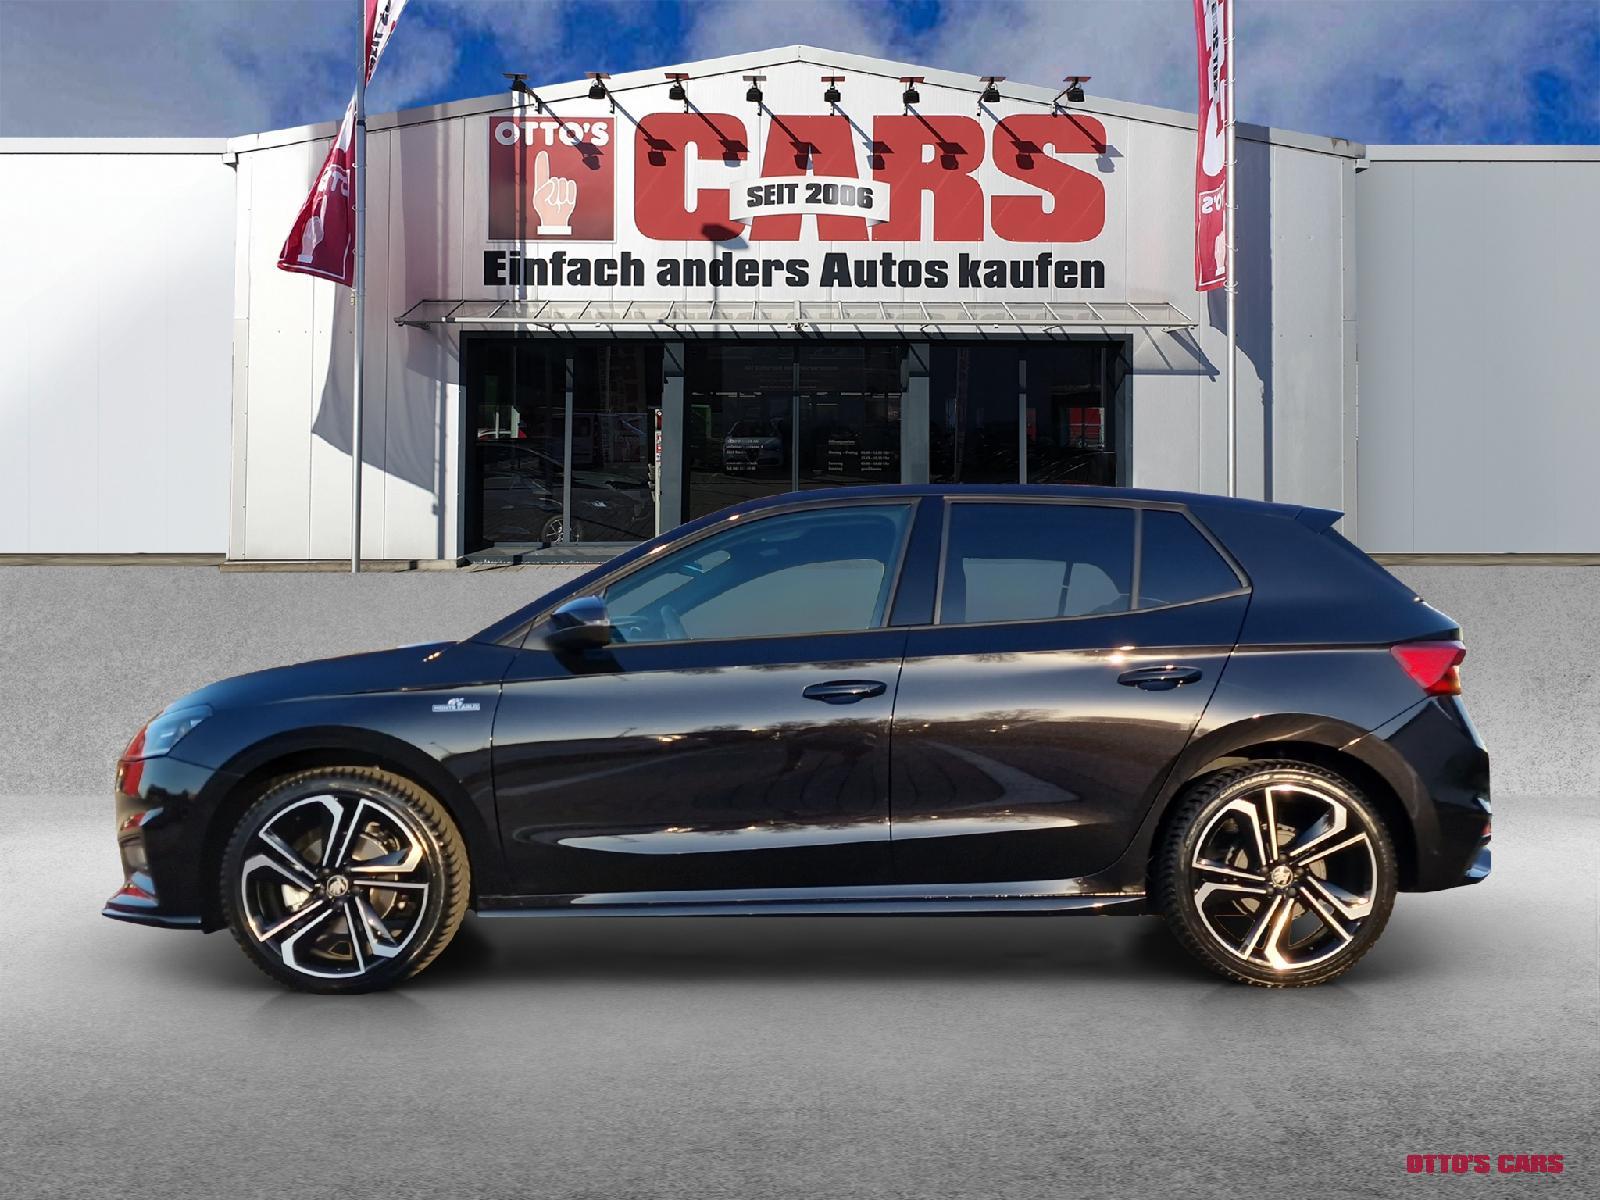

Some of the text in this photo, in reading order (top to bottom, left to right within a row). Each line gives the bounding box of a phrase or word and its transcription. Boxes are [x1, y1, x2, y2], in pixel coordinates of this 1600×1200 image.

[494, 121, 609, 147] OTTO'S
[634, 112, 1106, 243] CARS
[747, 182, 874, 209] SEIT 2006
[483, 251, 1105, 289] Einfach anders Autos kaufen
